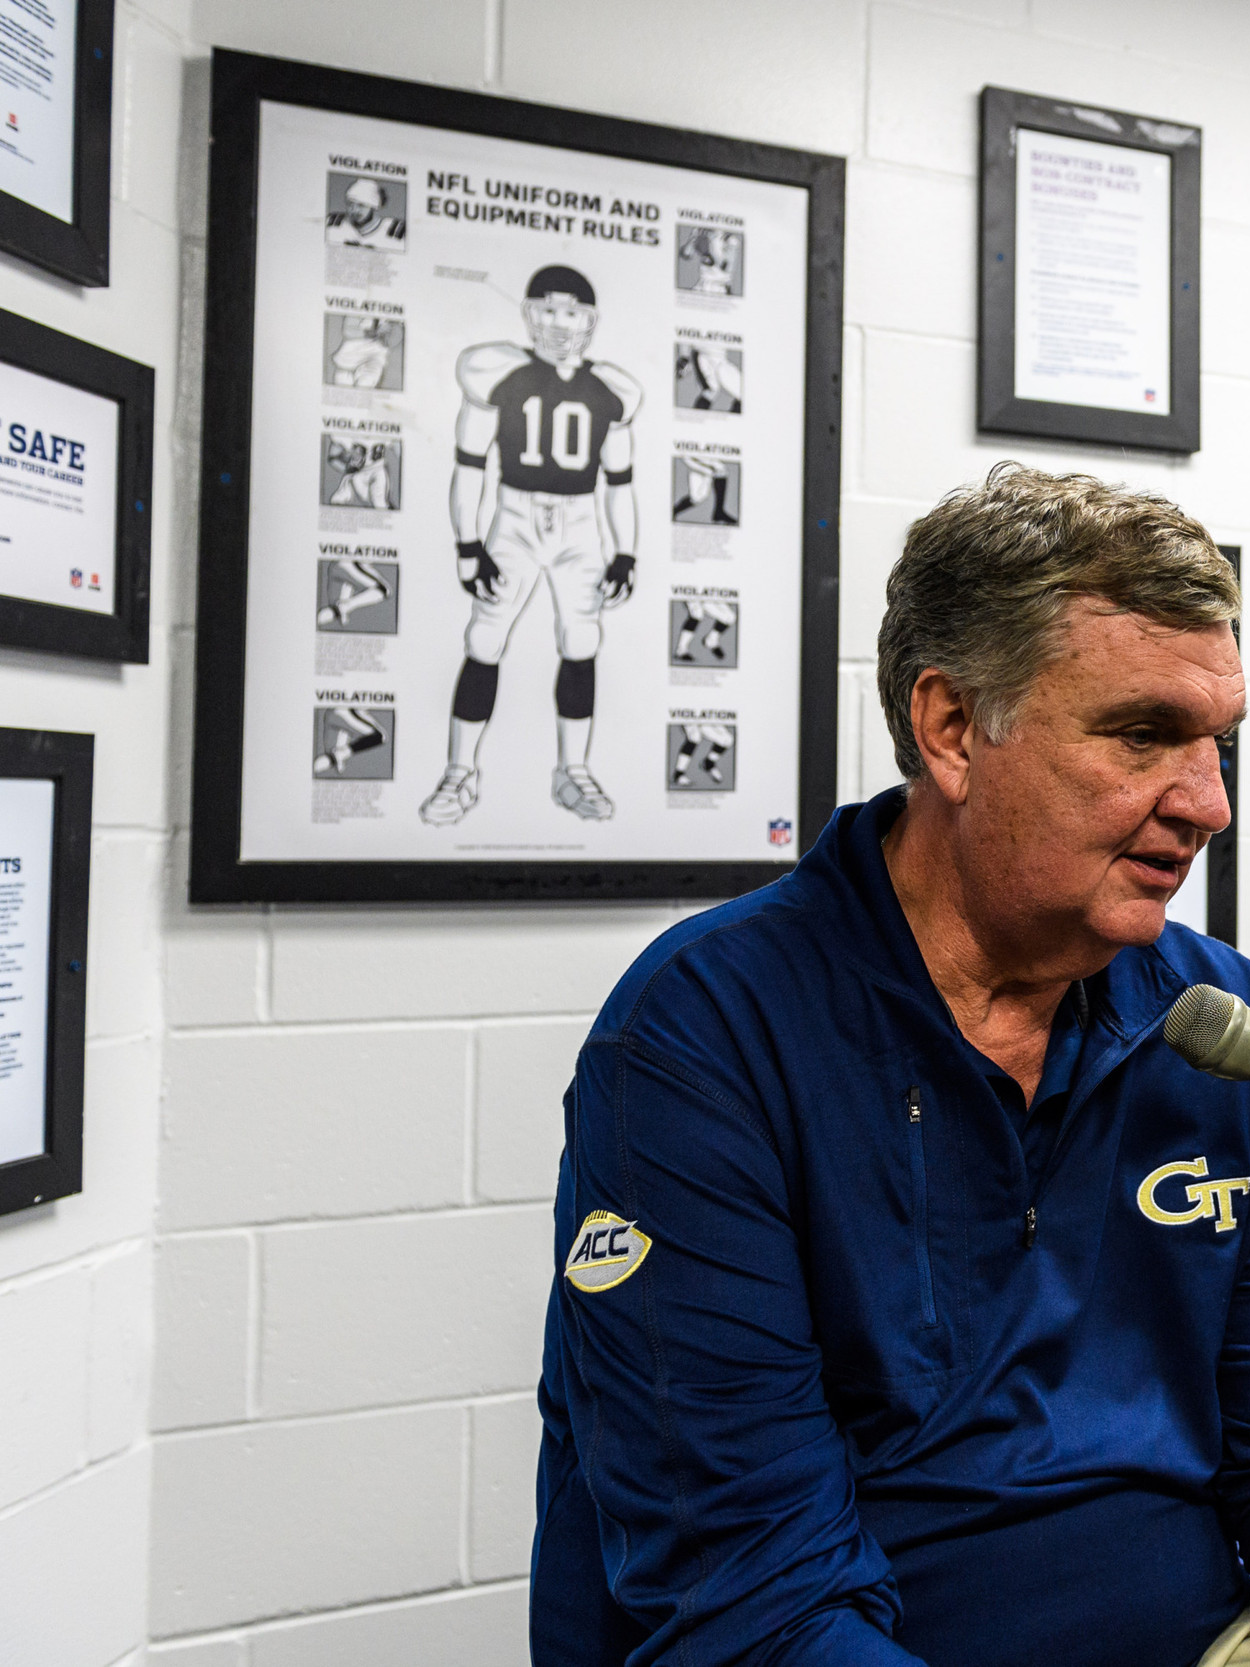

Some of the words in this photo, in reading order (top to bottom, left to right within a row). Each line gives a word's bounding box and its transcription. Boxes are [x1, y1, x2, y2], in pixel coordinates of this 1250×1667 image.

[328, 154, 407, 176] VIOLATION
[427, 170, 476, 196] NFL
[485, 181, 601, 212] UNIFORM
[609, 199, 660, 222] AND
[427, 196, 577, 233] EQUIPMENT
[583, 220, 660, 247] RULES
[676, 207, 745, 227] VIOLATION
[324, 296, 404, 314] VIOLATION
[674, 326, 743, 344] VIOLATION
[322, 417, 401, 434] VIOLATION
[519, 395, 592, 471] 10
[9, 423, 85, 471] SAFE
[673, 440, 741, 455] VIOLATION
[20, 461, 45, 476] YOUR
[46, 468, 84, 486] CAREER
[318, 543, 397, 558] VIOLATION
[671, 584, 739, 598] VIOLATION
[315, 690, 394, 704] VIOLATION
[668, 709, 737, 721] VIOLATION
[1136, 1156, 1250, 1233] GT
[572, 1225, 631, 1263] ACC
